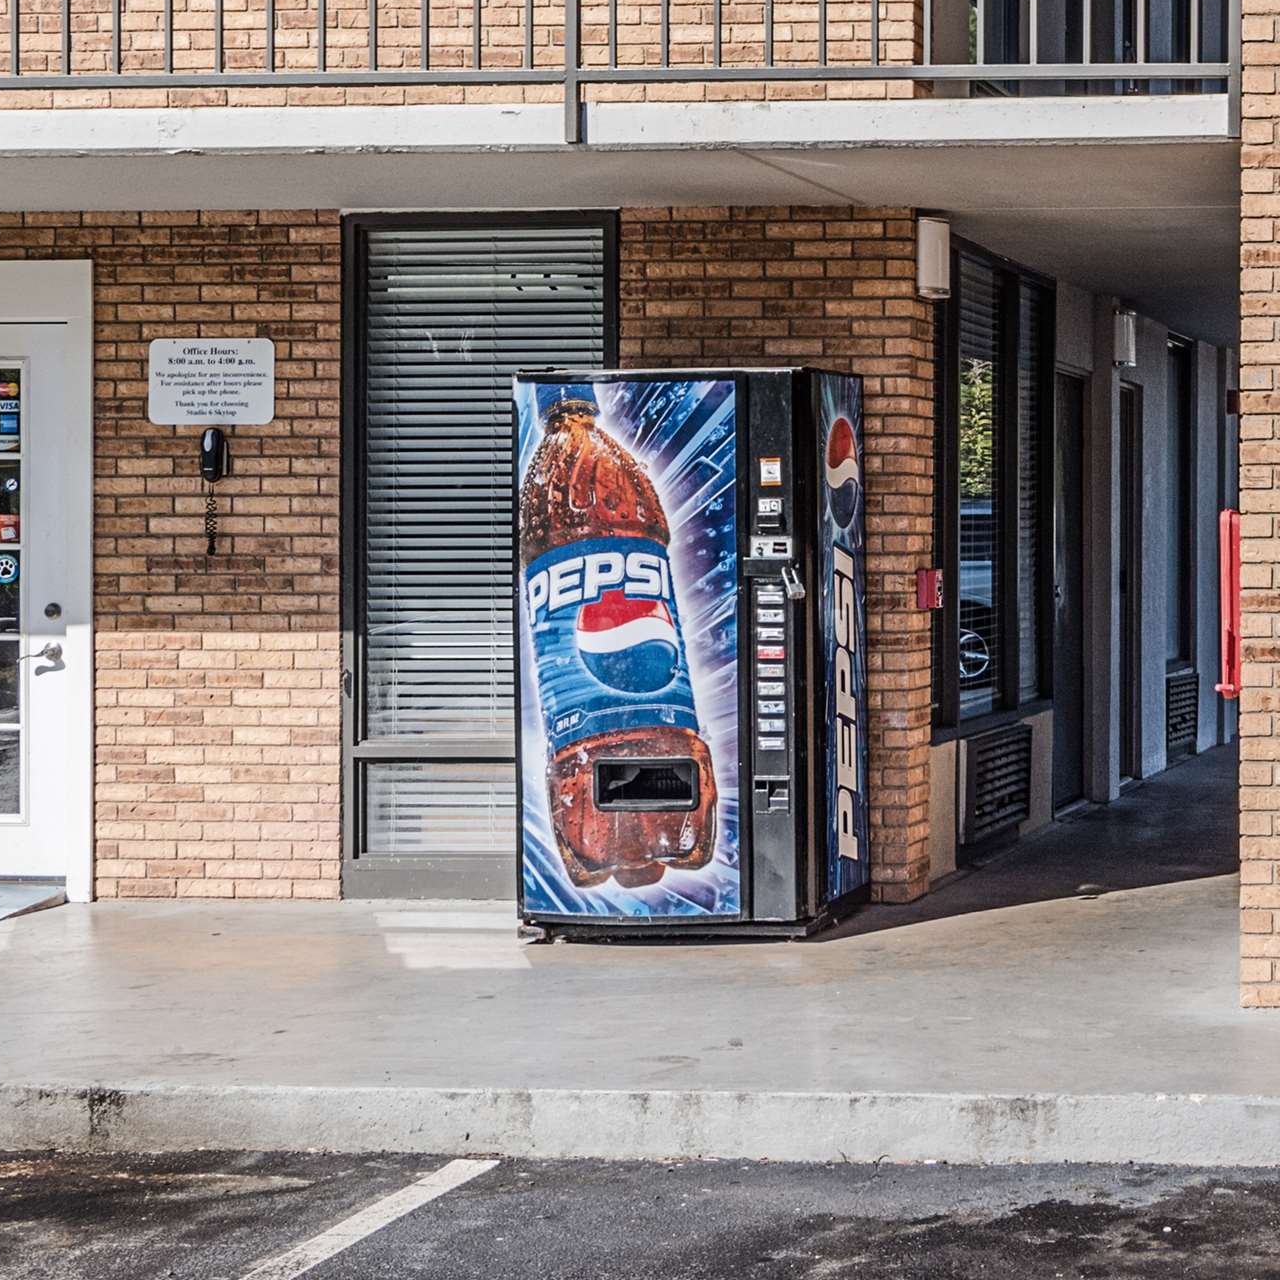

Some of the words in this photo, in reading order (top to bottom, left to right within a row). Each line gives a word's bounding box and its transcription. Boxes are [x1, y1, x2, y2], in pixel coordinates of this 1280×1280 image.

[182, 347, 208, 356] Office
[210, 347, 239, 356] Hours:
[208, 358, 216, 366] to
[167, 371, 196, 380] apologize
[243, 380, 263, 388] please
[182, 388, 195, 396] pick
[0, 402, 19, 410] VISA
[221, 400, 249, 408] choosing
[214, 408, 237, 417] Skytop
[528, 550, 670, 626] PEPSI
[834, 546, 861, 860] PEPSI
